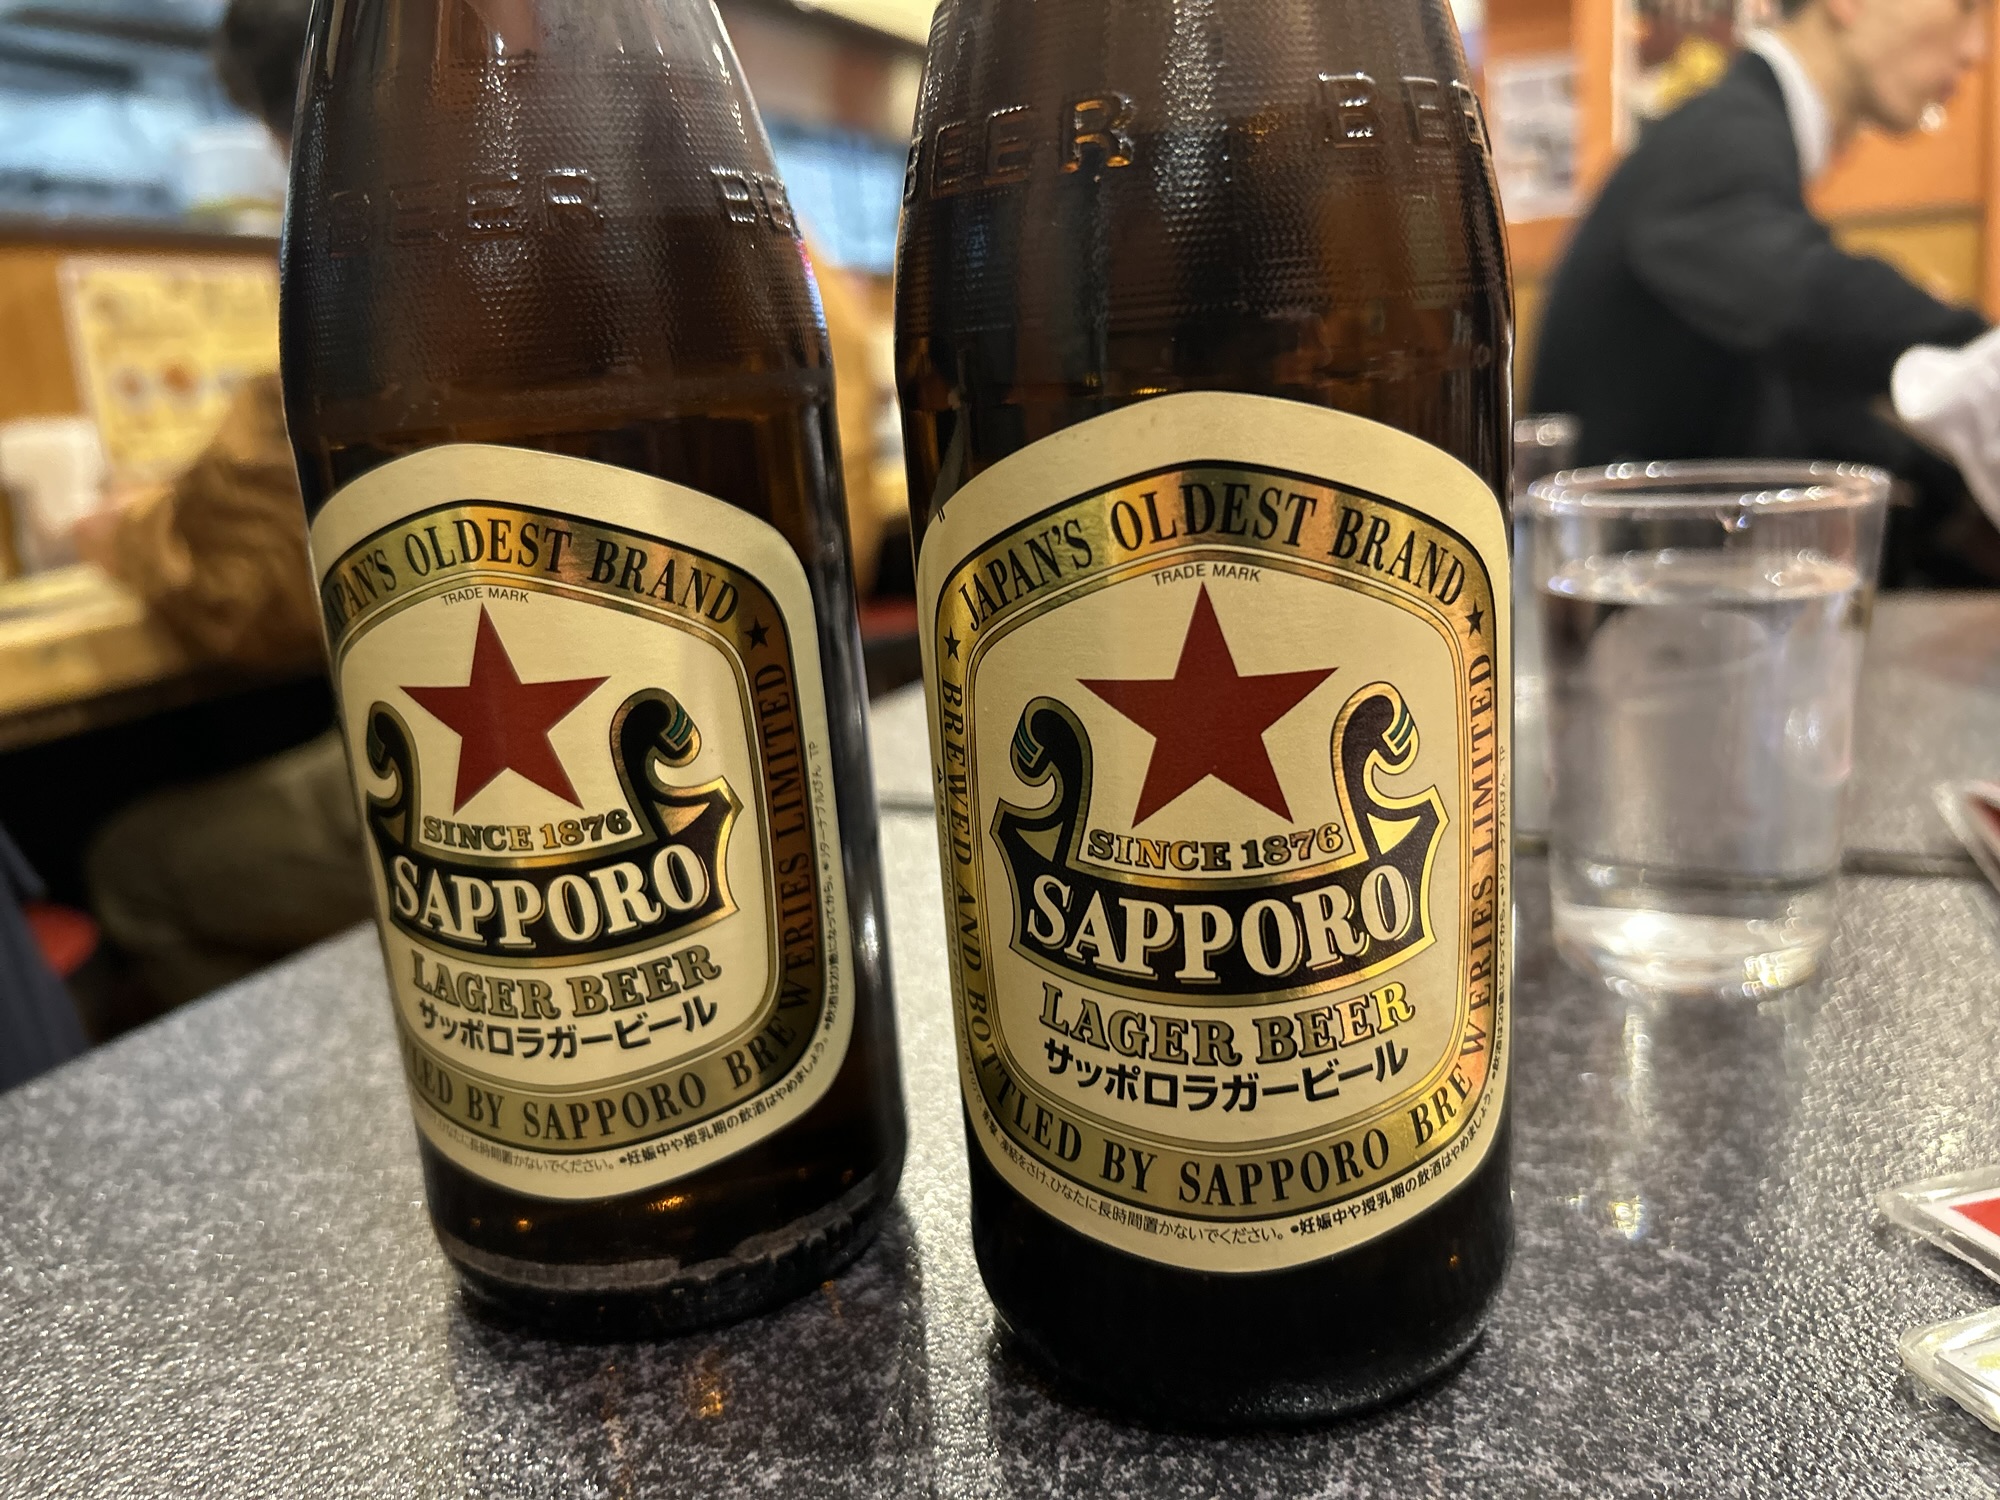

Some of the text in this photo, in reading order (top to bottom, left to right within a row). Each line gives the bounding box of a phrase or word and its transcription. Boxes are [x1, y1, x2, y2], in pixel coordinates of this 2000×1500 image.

[404, 519, 572, 577] OLDEST
[588, 537, 740, 625] BRAND
[442, 586, 530, 606] TRADE MARK
[957, 481, 1466, 632] JAPAN'S OLDEST BRAND
[1151, 563, 1262, 587] TRADE MARK
[754, 661, 807, 842] LIMITED
[942, 679, 973, 866] BREWED
[1467, 653, 1495, 863] LIMITED
[423, 808, 632, 852] SINCE 1876
[1087, 824, 1344, 871] SINCE 1876
[393, 842, 711, 950] SAPPORO
[955, 880, 982, 973] AND
[1026, 865, 1416, 983] SAPPORO
[411, 944, 723, 1020] LAGER BEER
[722, 850, 817, 1090] BREWERIES
[1407, 873, 1494, 1149] BREWERIES
[417, 995, 718, 1060] サッポロラガービール
[1039, 980, 1416, 1067] LAGER BEER
[466, 1083, 505, 1129] BY
[523, 1071, 707, 1142] SAPPORO
[966, 982, 1082, 1163] BOTTLED
[1045, 1037, 1410, 1114] サッポロラガービール
[1099, 1141, 1158, 1194] BY
[1178, 1127, 1390, 1207] SAPPORO
